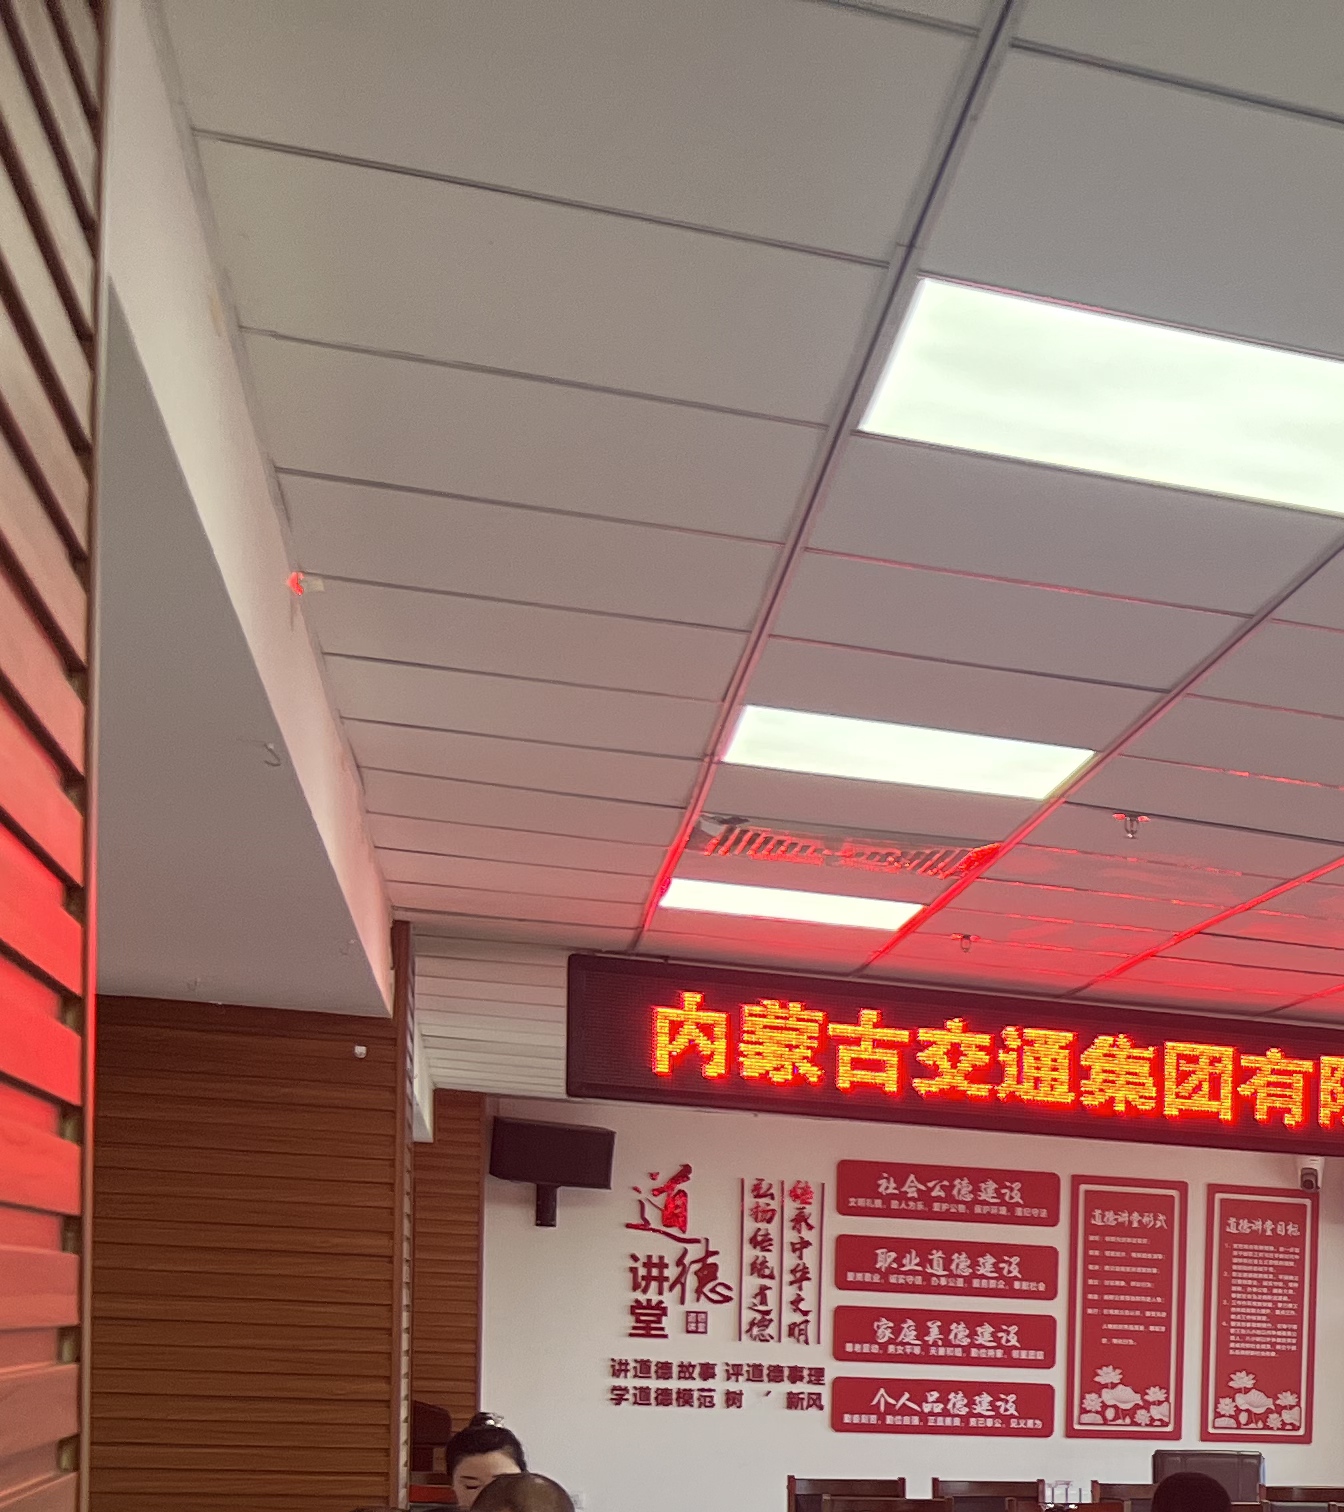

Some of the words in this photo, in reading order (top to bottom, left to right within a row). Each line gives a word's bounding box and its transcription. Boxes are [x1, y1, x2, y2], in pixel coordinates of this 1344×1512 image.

[877, 1172, 1024, 1204] 社会公德建设
[1226, 1217, 1300, 1237] 道德讲堂目标
[746, 1178, 777, 1342] 弘扬传统道德
[875, 1248, 1022, 1278] 职业道德建设
[629, 1253, 670, 1339] 讲堂
[873, 1317, 1021, 1347] 家庭美德建设
[610, 1358, 717, 1381] 讲道德故事
[725, 1361, 826, 1385] 评道德事理
[610, 1385, 716, 1409] 学道德模范
[786, 1390, 825, 1411] 新风
[871, 1387, 1019, 1416] 个人品德建设
